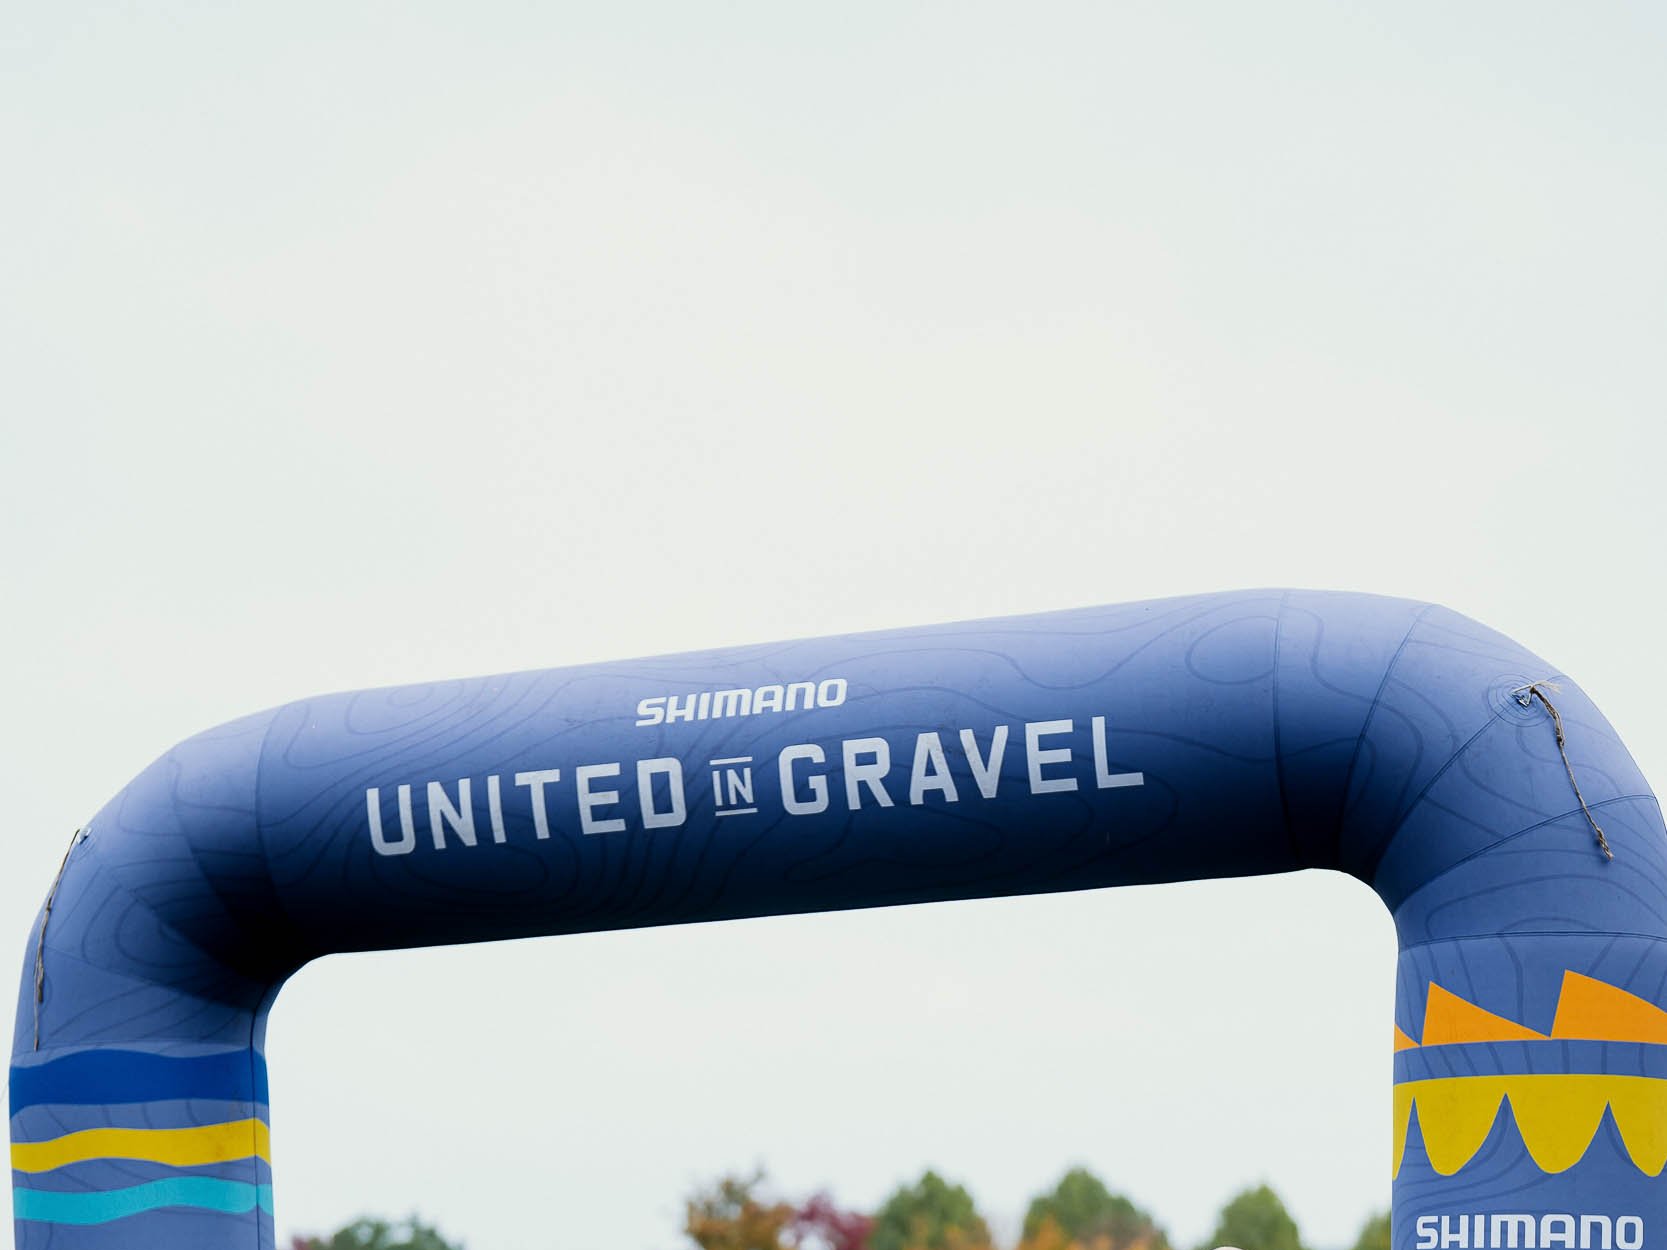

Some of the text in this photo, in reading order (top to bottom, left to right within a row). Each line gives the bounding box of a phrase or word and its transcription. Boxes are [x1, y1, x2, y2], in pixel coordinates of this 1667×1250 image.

[635, 678, 848, 727] SHIMANO
[366, 716, 1145, 857] UNITED IN GRAVEL
[1416, 1214, 1644, 1250] SHIMANO
